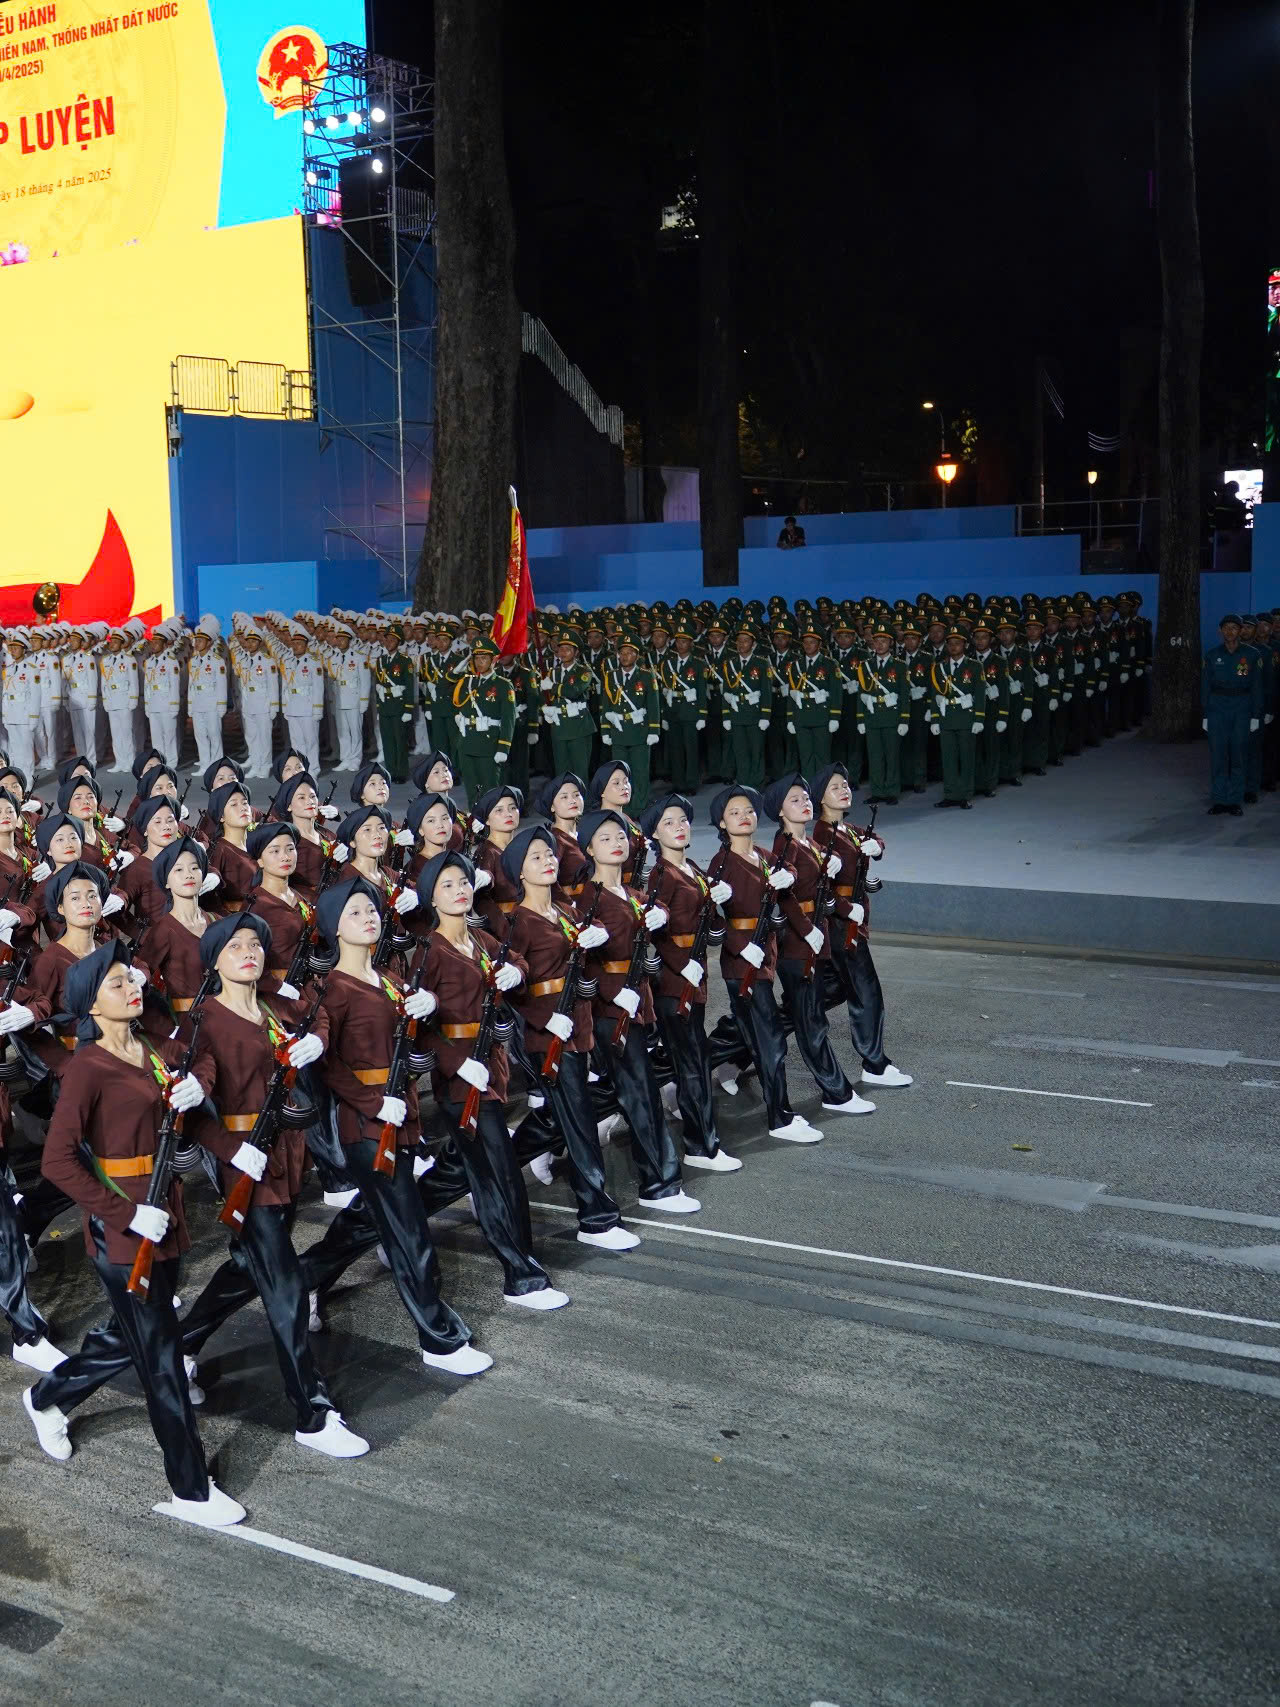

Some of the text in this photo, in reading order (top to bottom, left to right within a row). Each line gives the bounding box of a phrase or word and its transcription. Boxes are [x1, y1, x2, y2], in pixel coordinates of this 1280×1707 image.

[18, 4, 56, 31] HÀNH
[52, 25, 88, 48] THỐNG
[90, 15, 119, 39] NHẤT
[122, 8, 144, 30] ĐẤT
[147, 2, 178, 24] NƯỚC
[19, 93, 115, 155] LUYỆN
[15, 186, 26, 198] 18
[57, 178, 63, 188] 4
[88, 167, 112, 183] 2025
